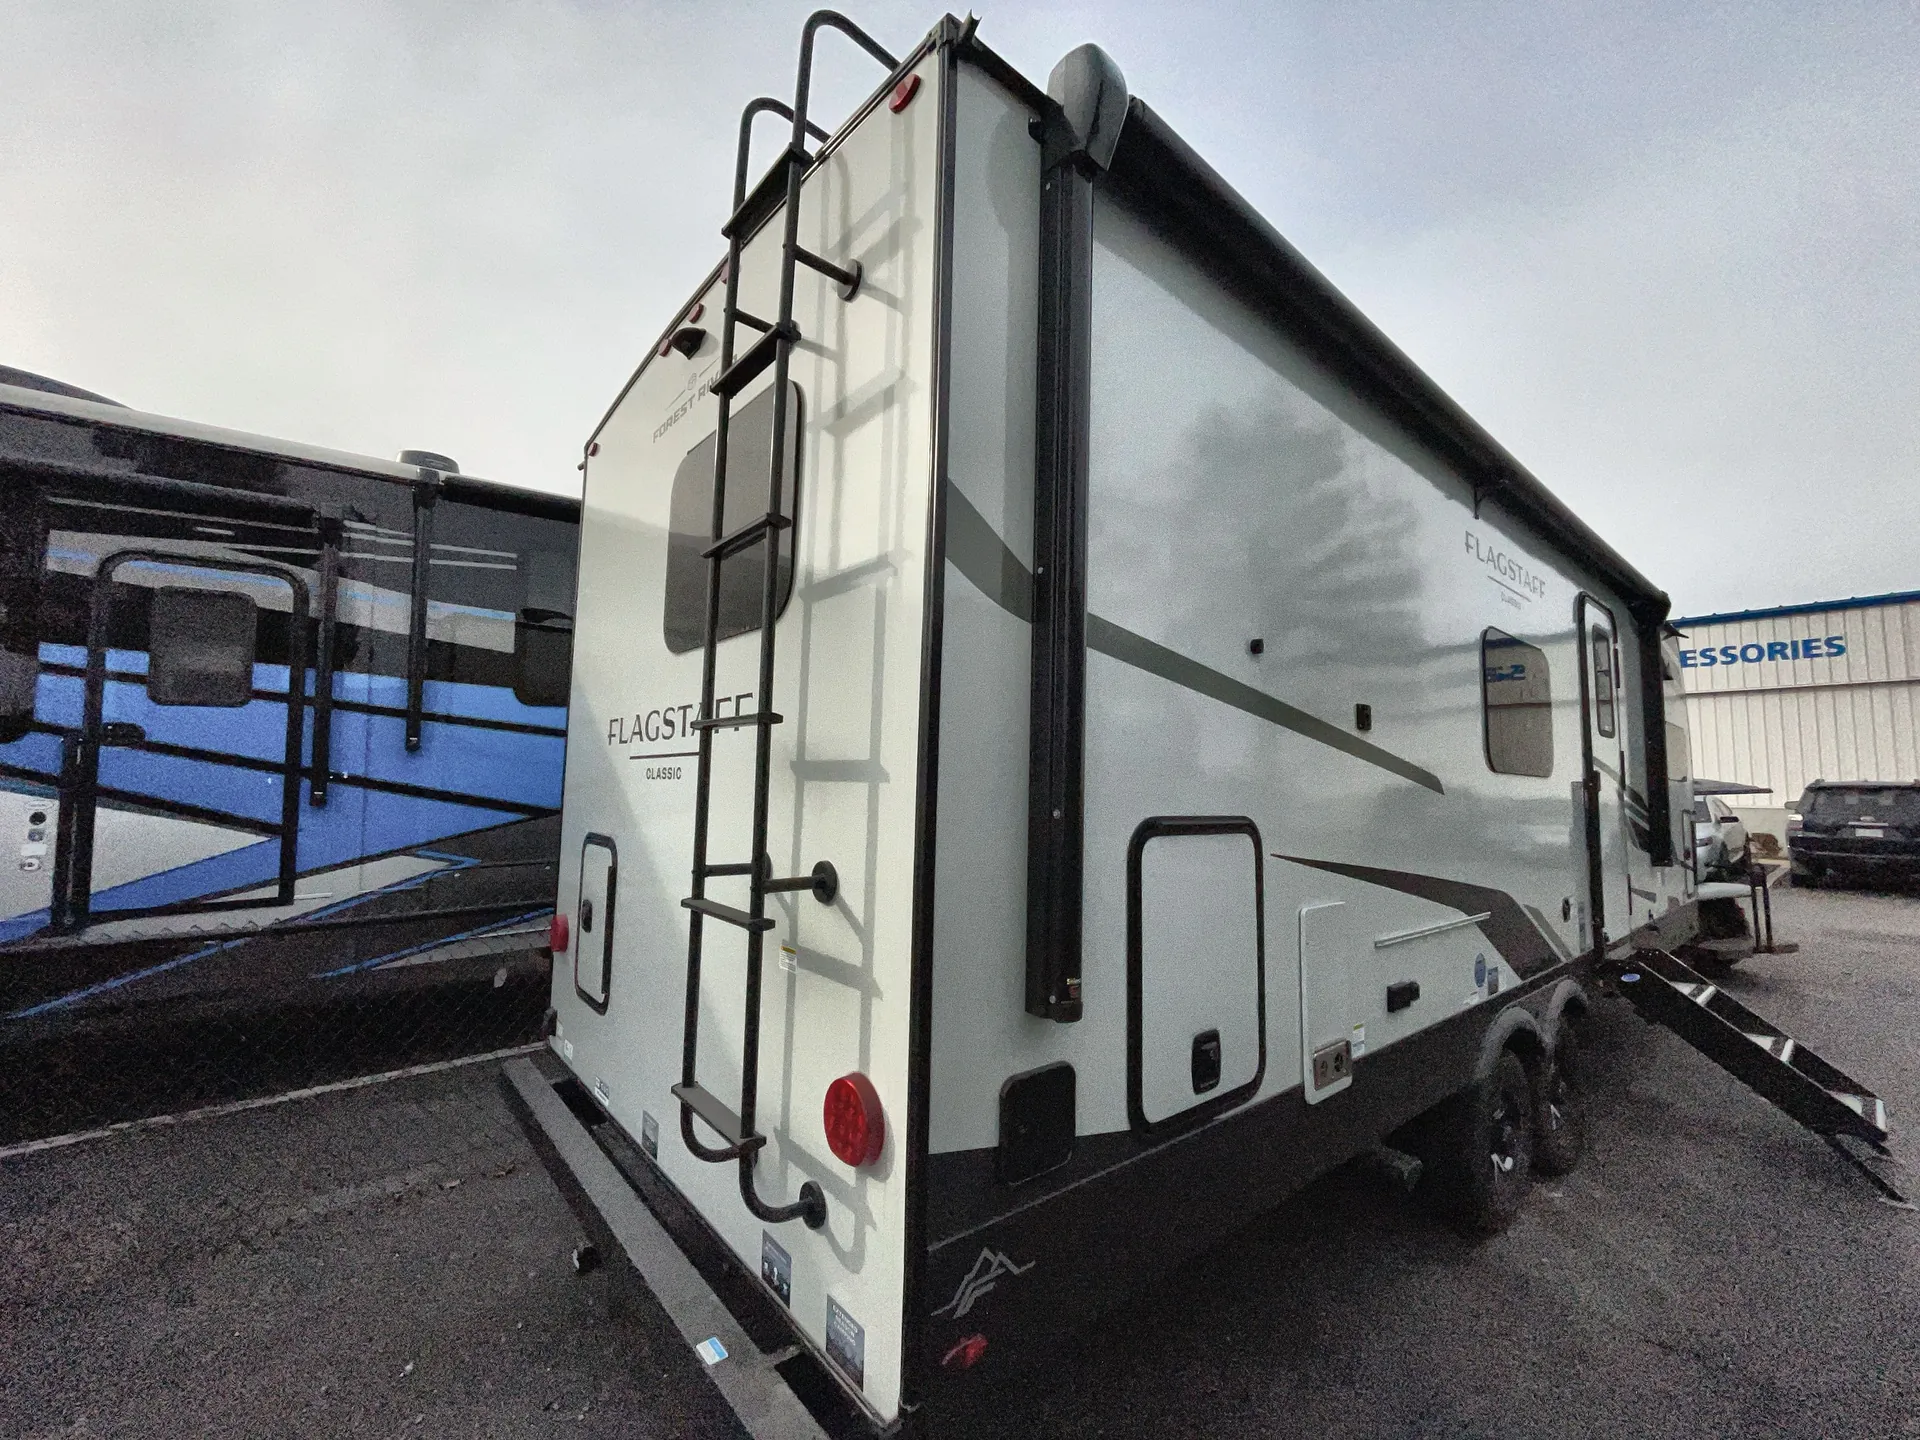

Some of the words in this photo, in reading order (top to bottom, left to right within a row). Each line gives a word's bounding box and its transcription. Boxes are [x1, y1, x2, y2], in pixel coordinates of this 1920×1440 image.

[653, 394, 696, 443] FOREST
[1465, 530, 1545, 599] FLAGSTAFF
[645, 766, 682, 780] CLASSIC
